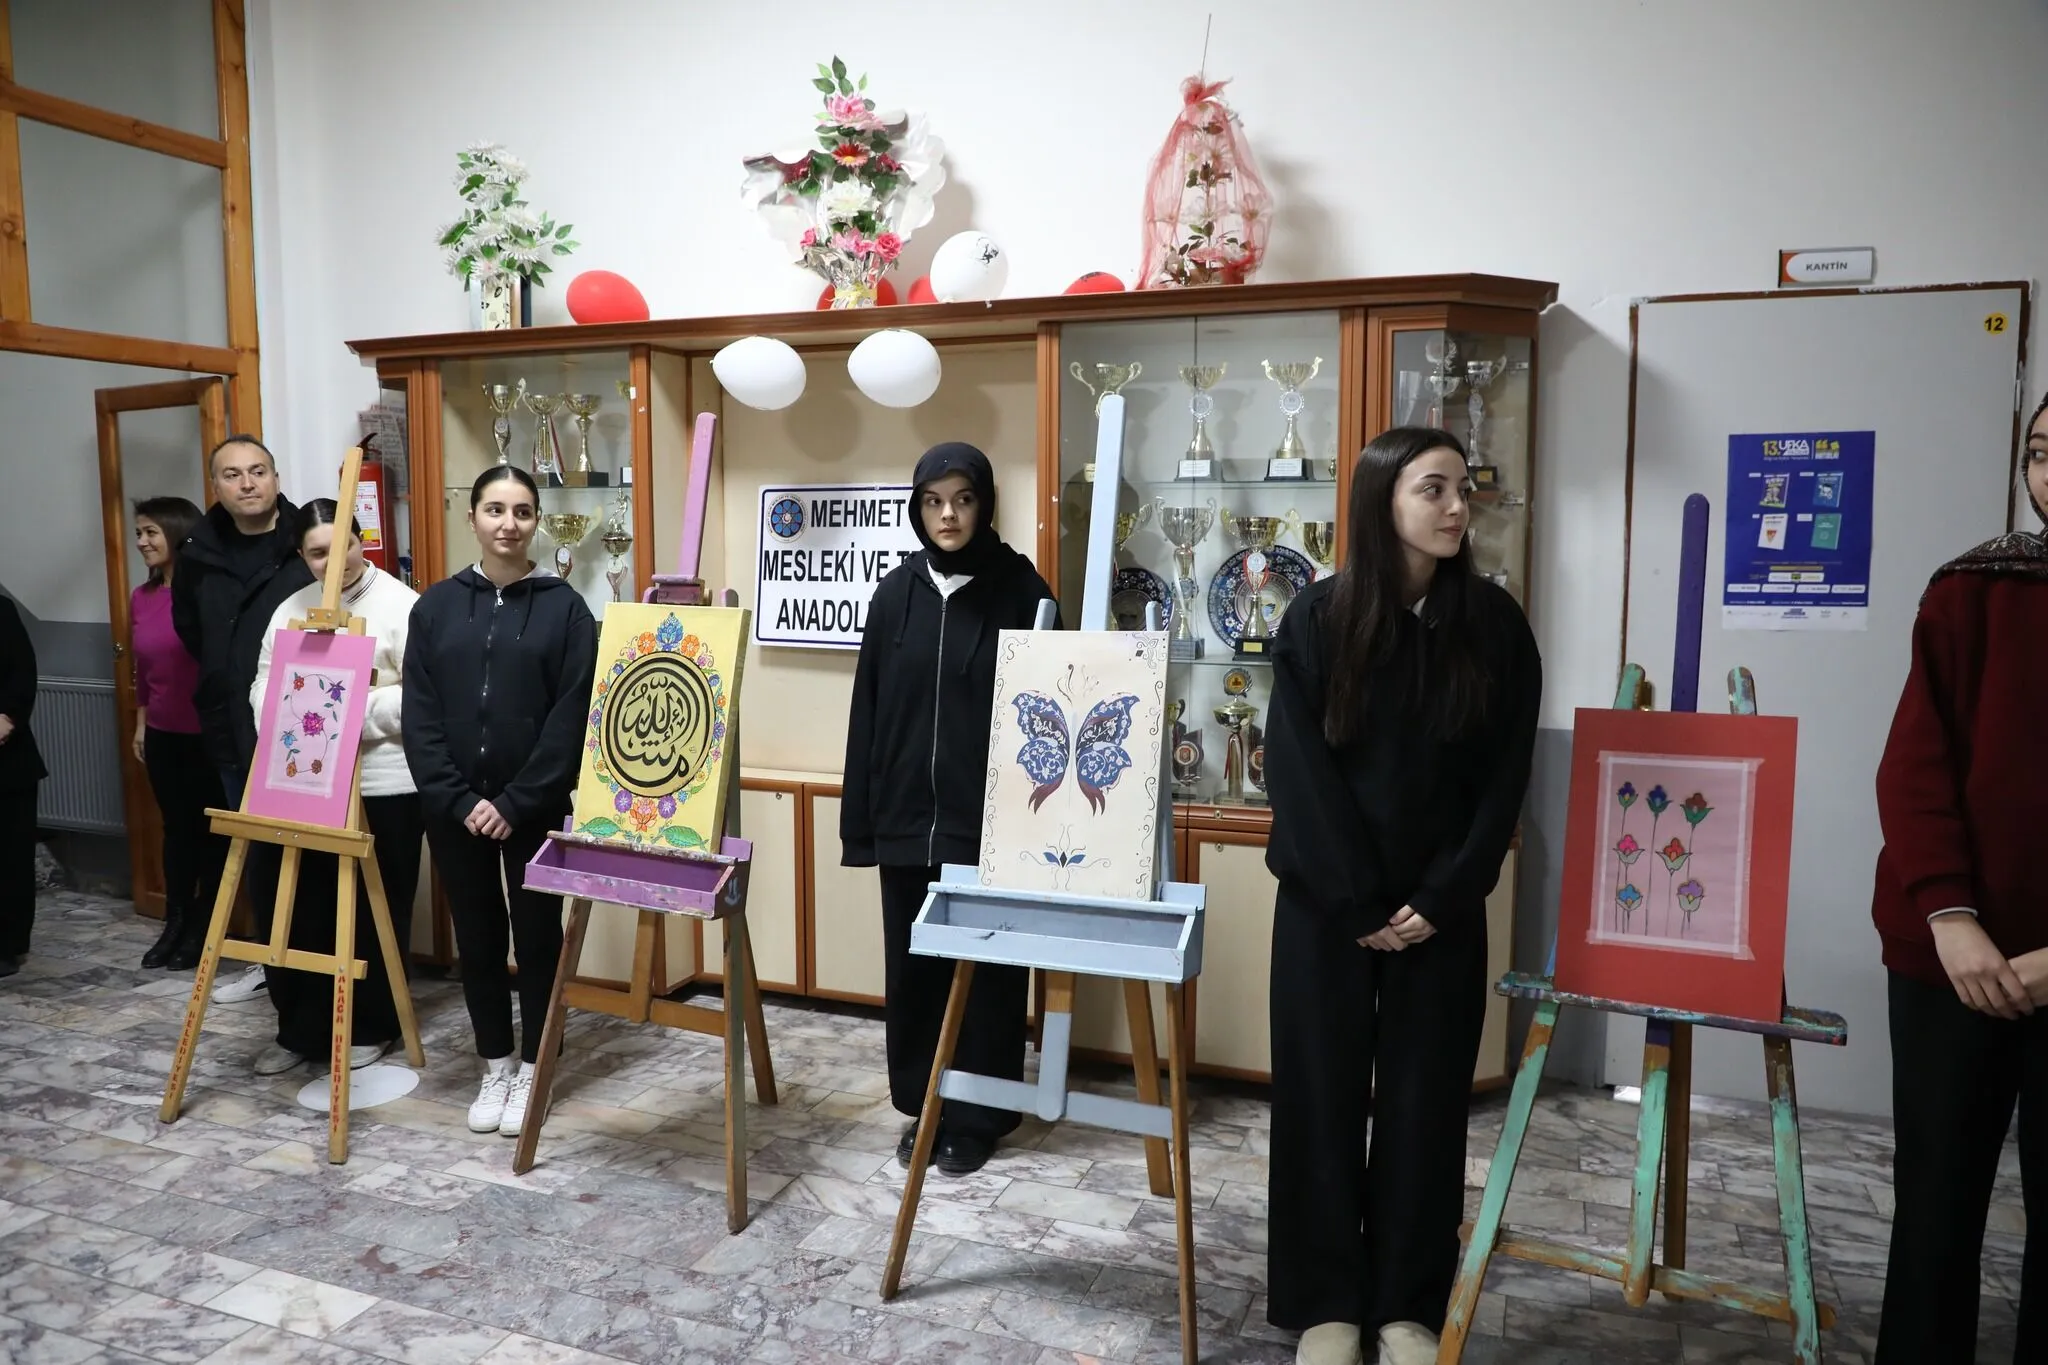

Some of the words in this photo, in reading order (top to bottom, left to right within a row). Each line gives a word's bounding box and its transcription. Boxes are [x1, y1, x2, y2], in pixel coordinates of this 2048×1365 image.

[1805, 260, 1848, 272] KANTİN
[1984, 316, 2004, 332] 12
[810, 499, 906, 528] MEHMET
[763, 541, 854, 583] MESLEKİ
[861, 550, 889, 583] VE
[775, 598, 871, 633] ANADOL
[193, 958, 208, 1001] ALACA
[336, 975, 346, 1024] ALACA
